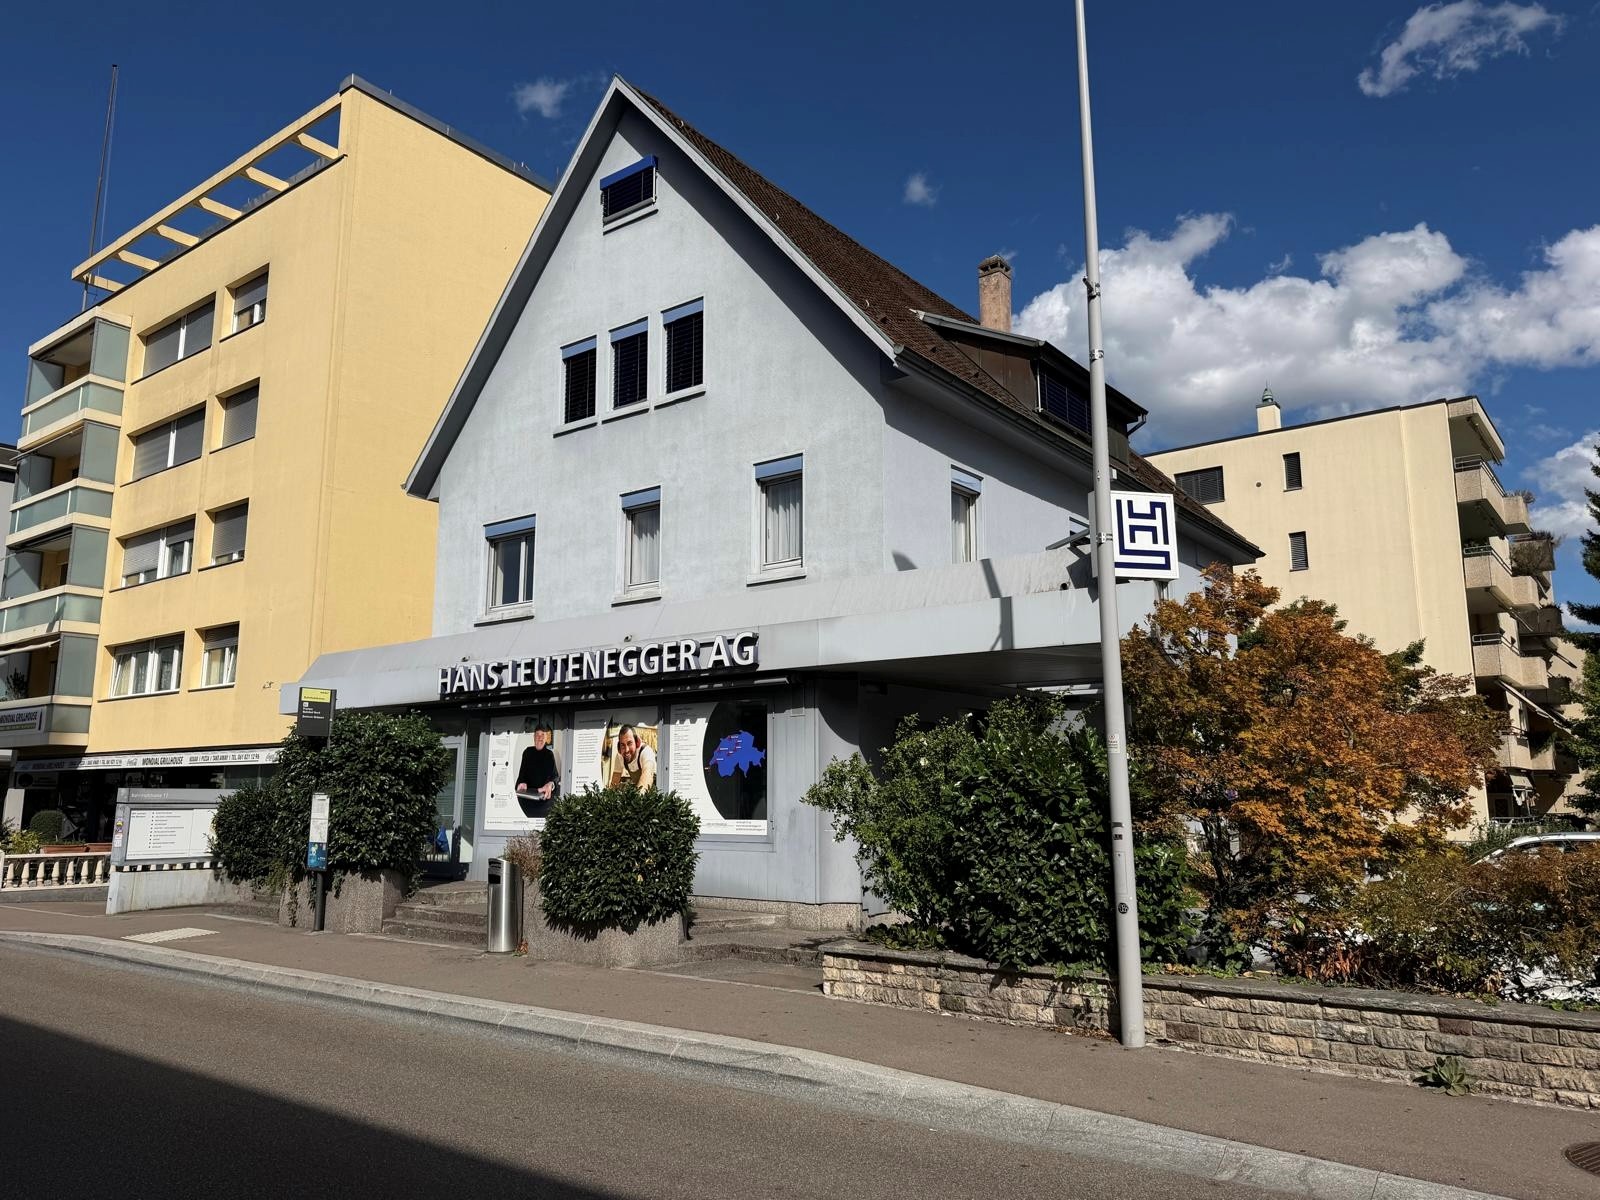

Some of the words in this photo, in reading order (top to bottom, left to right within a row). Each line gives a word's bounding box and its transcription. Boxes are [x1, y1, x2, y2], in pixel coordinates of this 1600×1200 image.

[438, 663, 500, 694] HANS
[507, 640, 698, 687] LEUTENEGGER
[707, 632, 757, 669] AG
